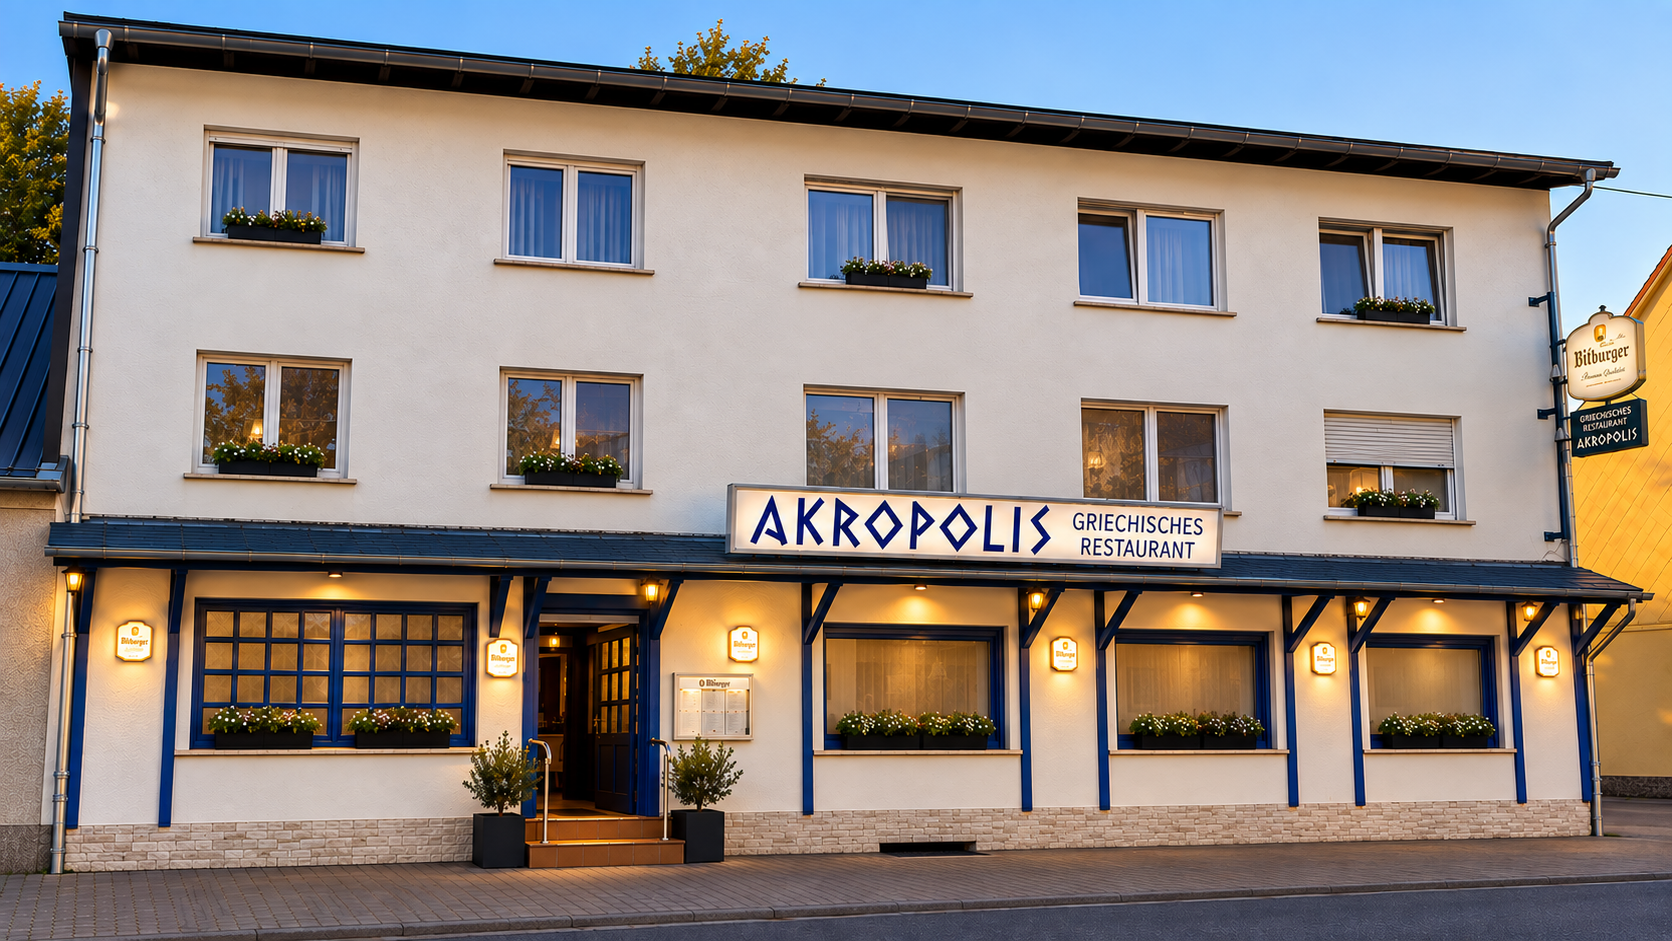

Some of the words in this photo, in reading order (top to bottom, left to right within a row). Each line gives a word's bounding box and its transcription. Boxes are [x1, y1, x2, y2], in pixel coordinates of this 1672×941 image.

[1574, 346, 1629, 368] Bitburger
[1577, 427, 1638, 449] AKROPOLIS
[750, 495, 1052, 555] AKROPOLIS
[1072, 512, 1204, 536] GRIECHISCHES
[1080, 537, 1195, 559] RESTAURANT
